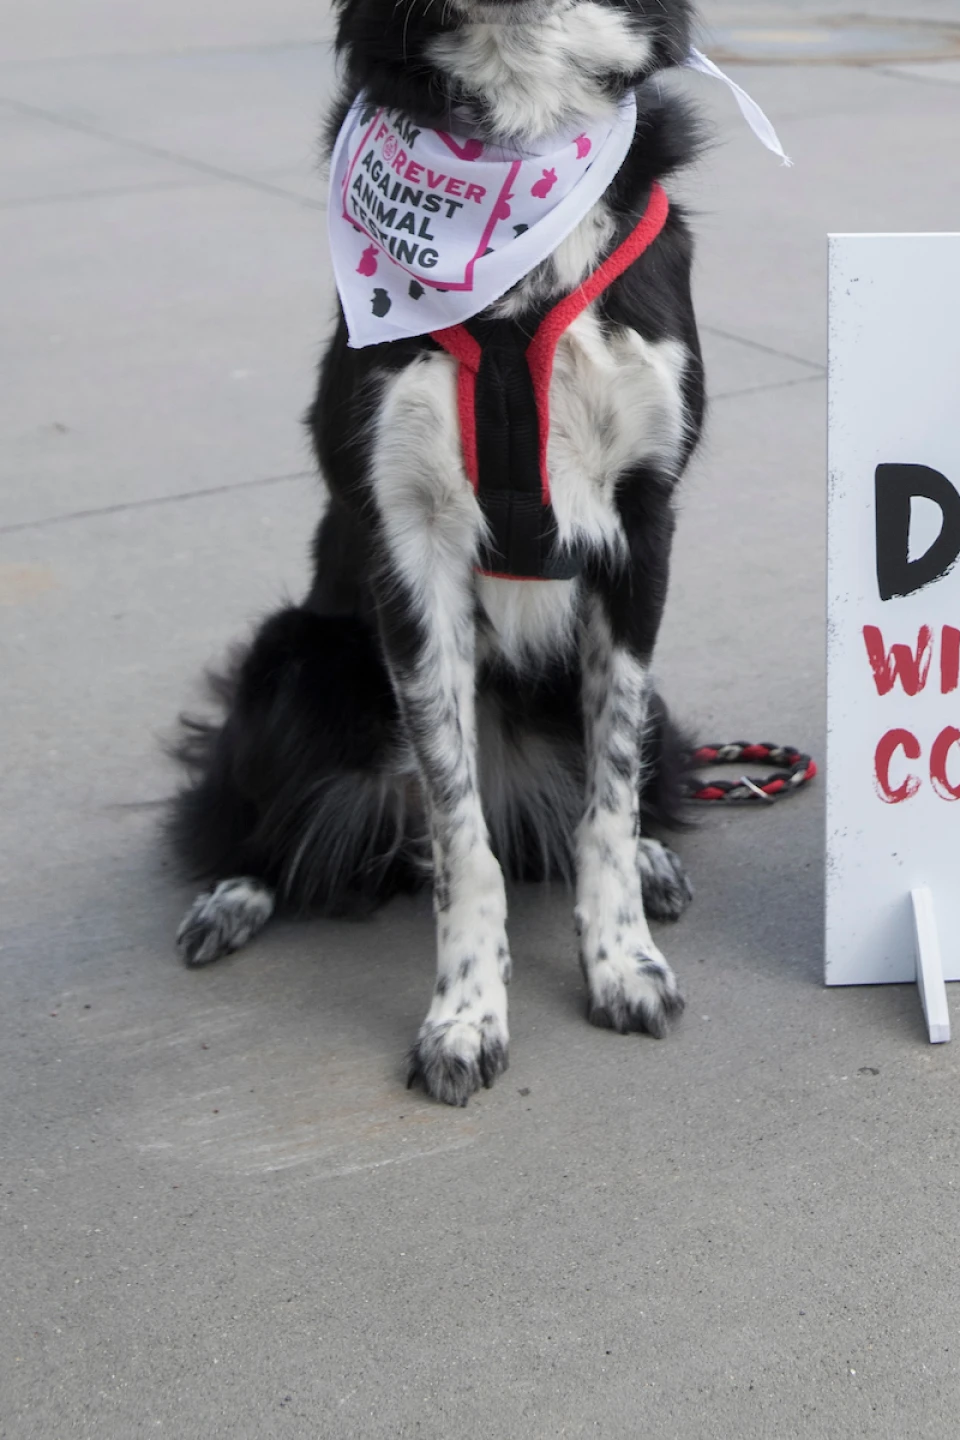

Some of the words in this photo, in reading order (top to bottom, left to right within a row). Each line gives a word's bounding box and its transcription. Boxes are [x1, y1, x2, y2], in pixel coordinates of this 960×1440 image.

[353, 173, 434, 241] ANIMAL
[362, 149, 464, 219] AGAINST
[351, 194, 439, 269] TESTING
